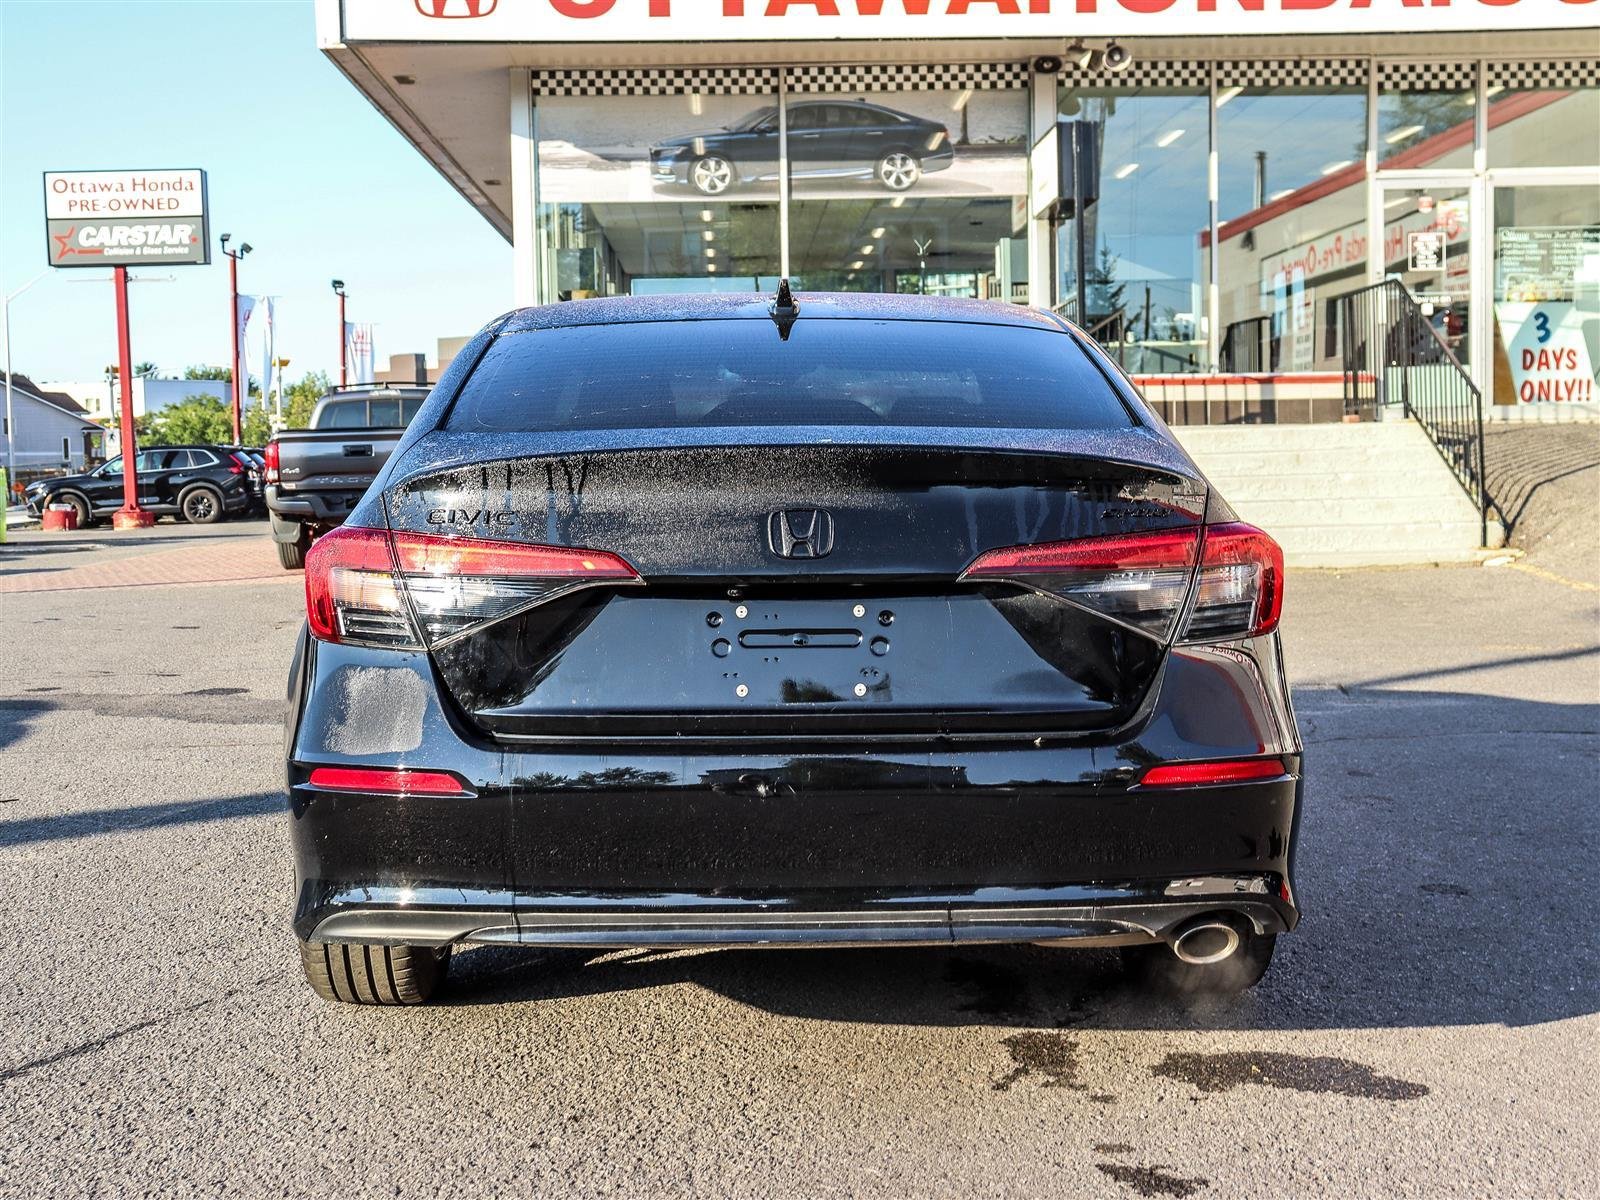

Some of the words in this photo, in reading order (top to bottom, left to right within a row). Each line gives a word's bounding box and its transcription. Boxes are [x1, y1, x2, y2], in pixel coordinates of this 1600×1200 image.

[52, 179, 125, 194] Ottawa
[132, 176, 194, 192] Honda
[68, 197, 180, 212] PRE-OWNED
[78, 224, 193, 247] CARSTAR
[163, 246, 190, 255] Service
[1534, 311, 1551, 344] 3
[1521, 347, 1577, 371] DAYS
[1520, 378, 1592, 403] ONLY!!
[426, 508, 516, 526] CIVIC
